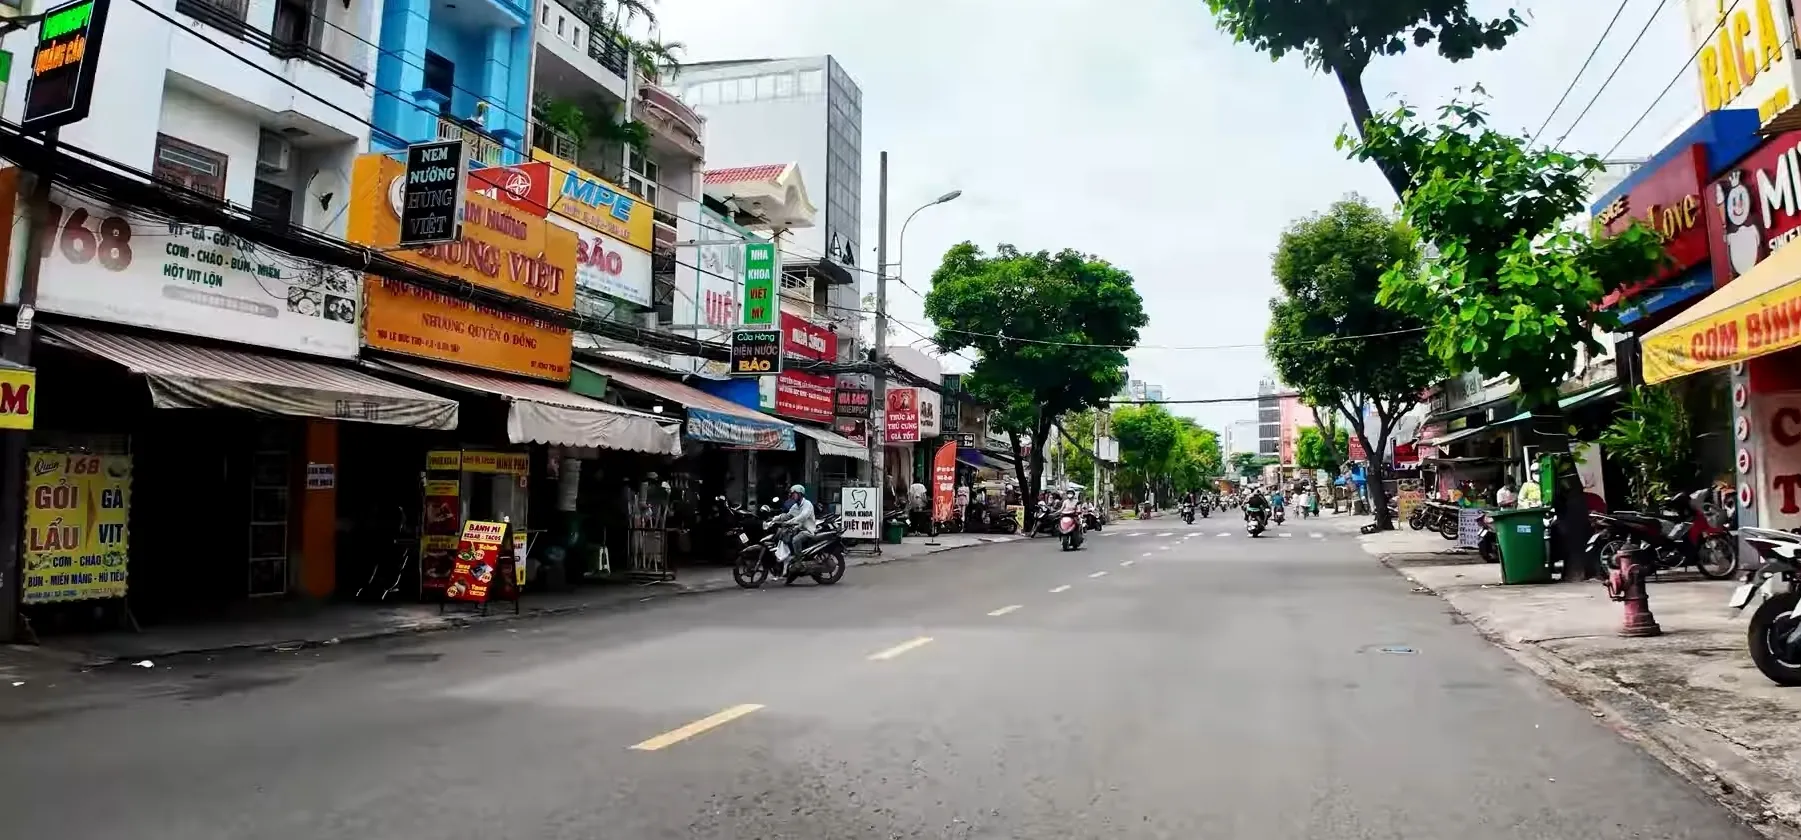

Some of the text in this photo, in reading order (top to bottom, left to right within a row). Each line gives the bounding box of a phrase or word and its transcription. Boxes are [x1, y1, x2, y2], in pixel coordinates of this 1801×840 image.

[421, 147, 448, 162] NEM
[410, 166, 456, 184] NƯỚNG
[407, 187, 453, 209] HÙNG
[560, 169, 636, 223] MPE
[411, 212, 447, 238] VIỆT
[166, 242, 189, 259] CƠM
[751, 249, 769, 261] NHA
[163, 263, 223, 288] HỘT VỊT LỘN
[507, 250, 565, 298] VIỆT
[748, 268, 771, 280] KHOA
[737, 332, 775, 342] Cửa Hàng
[733, 344, 753, 358] ĐIỆN
[754, 343, 779, 356] NƯỚC
[738, 357, 771, 371] BẢO
[34, 457, 59, 477] Quán
[34, 478, 124, 509] GỎI GÀ
[30, 516, 124, 551] LẨU VỊT
[53, 556, 72, 567] CƠM
